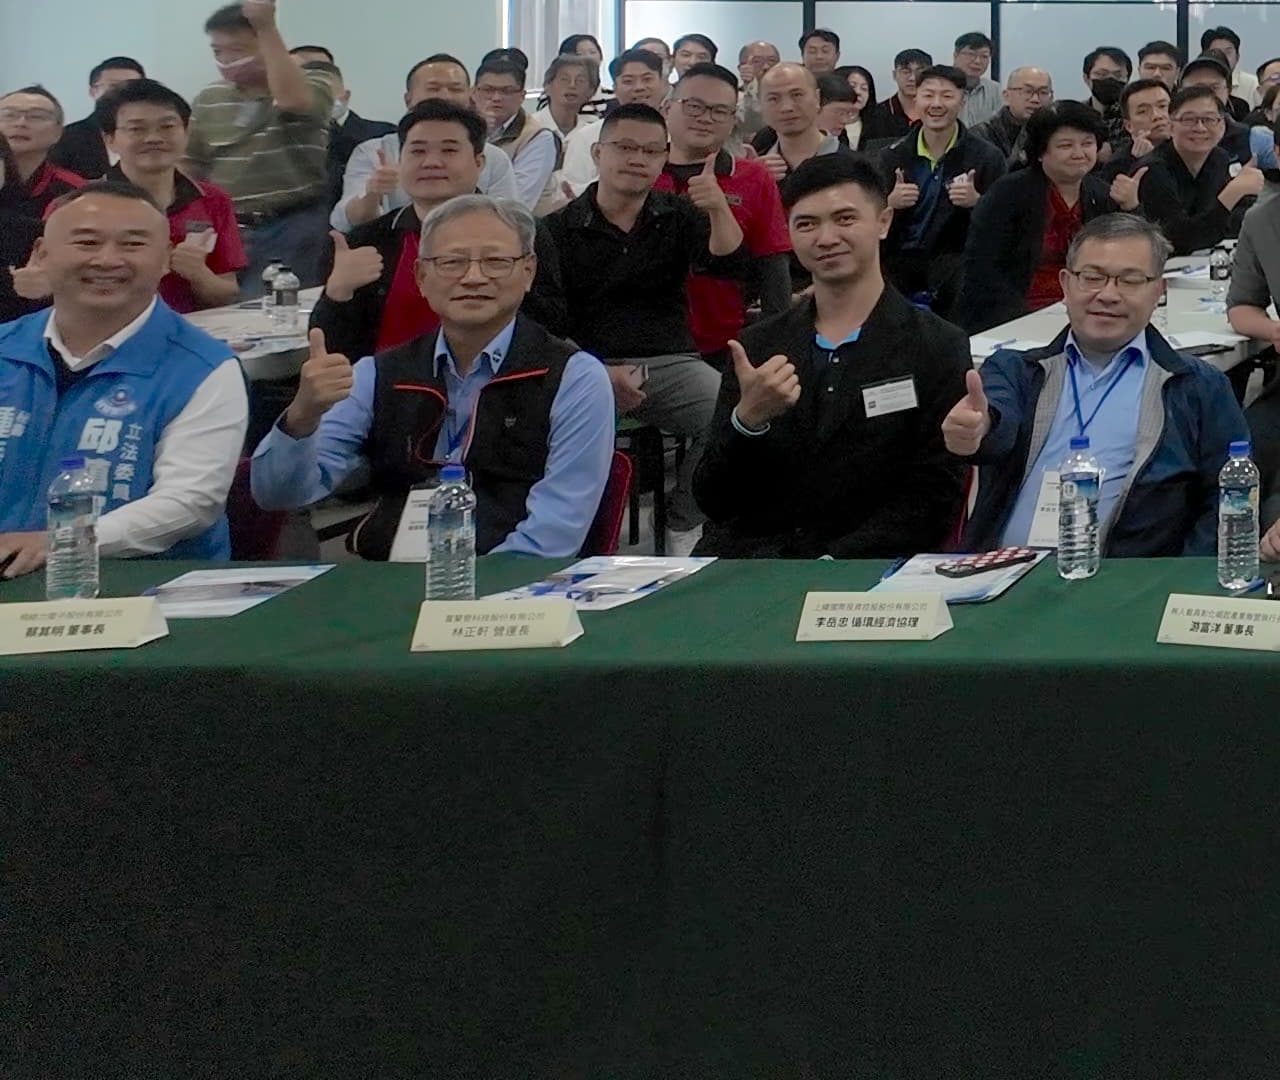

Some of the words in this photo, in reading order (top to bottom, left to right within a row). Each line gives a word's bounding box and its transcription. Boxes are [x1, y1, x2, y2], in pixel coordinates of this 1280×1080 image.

[112, 422, 143, 501] 立法委員
[67, 623, 106, 636] 董事長
[493, 624, 531, 637] 營運長
[1223, 623, 1255, 637] 董事長
